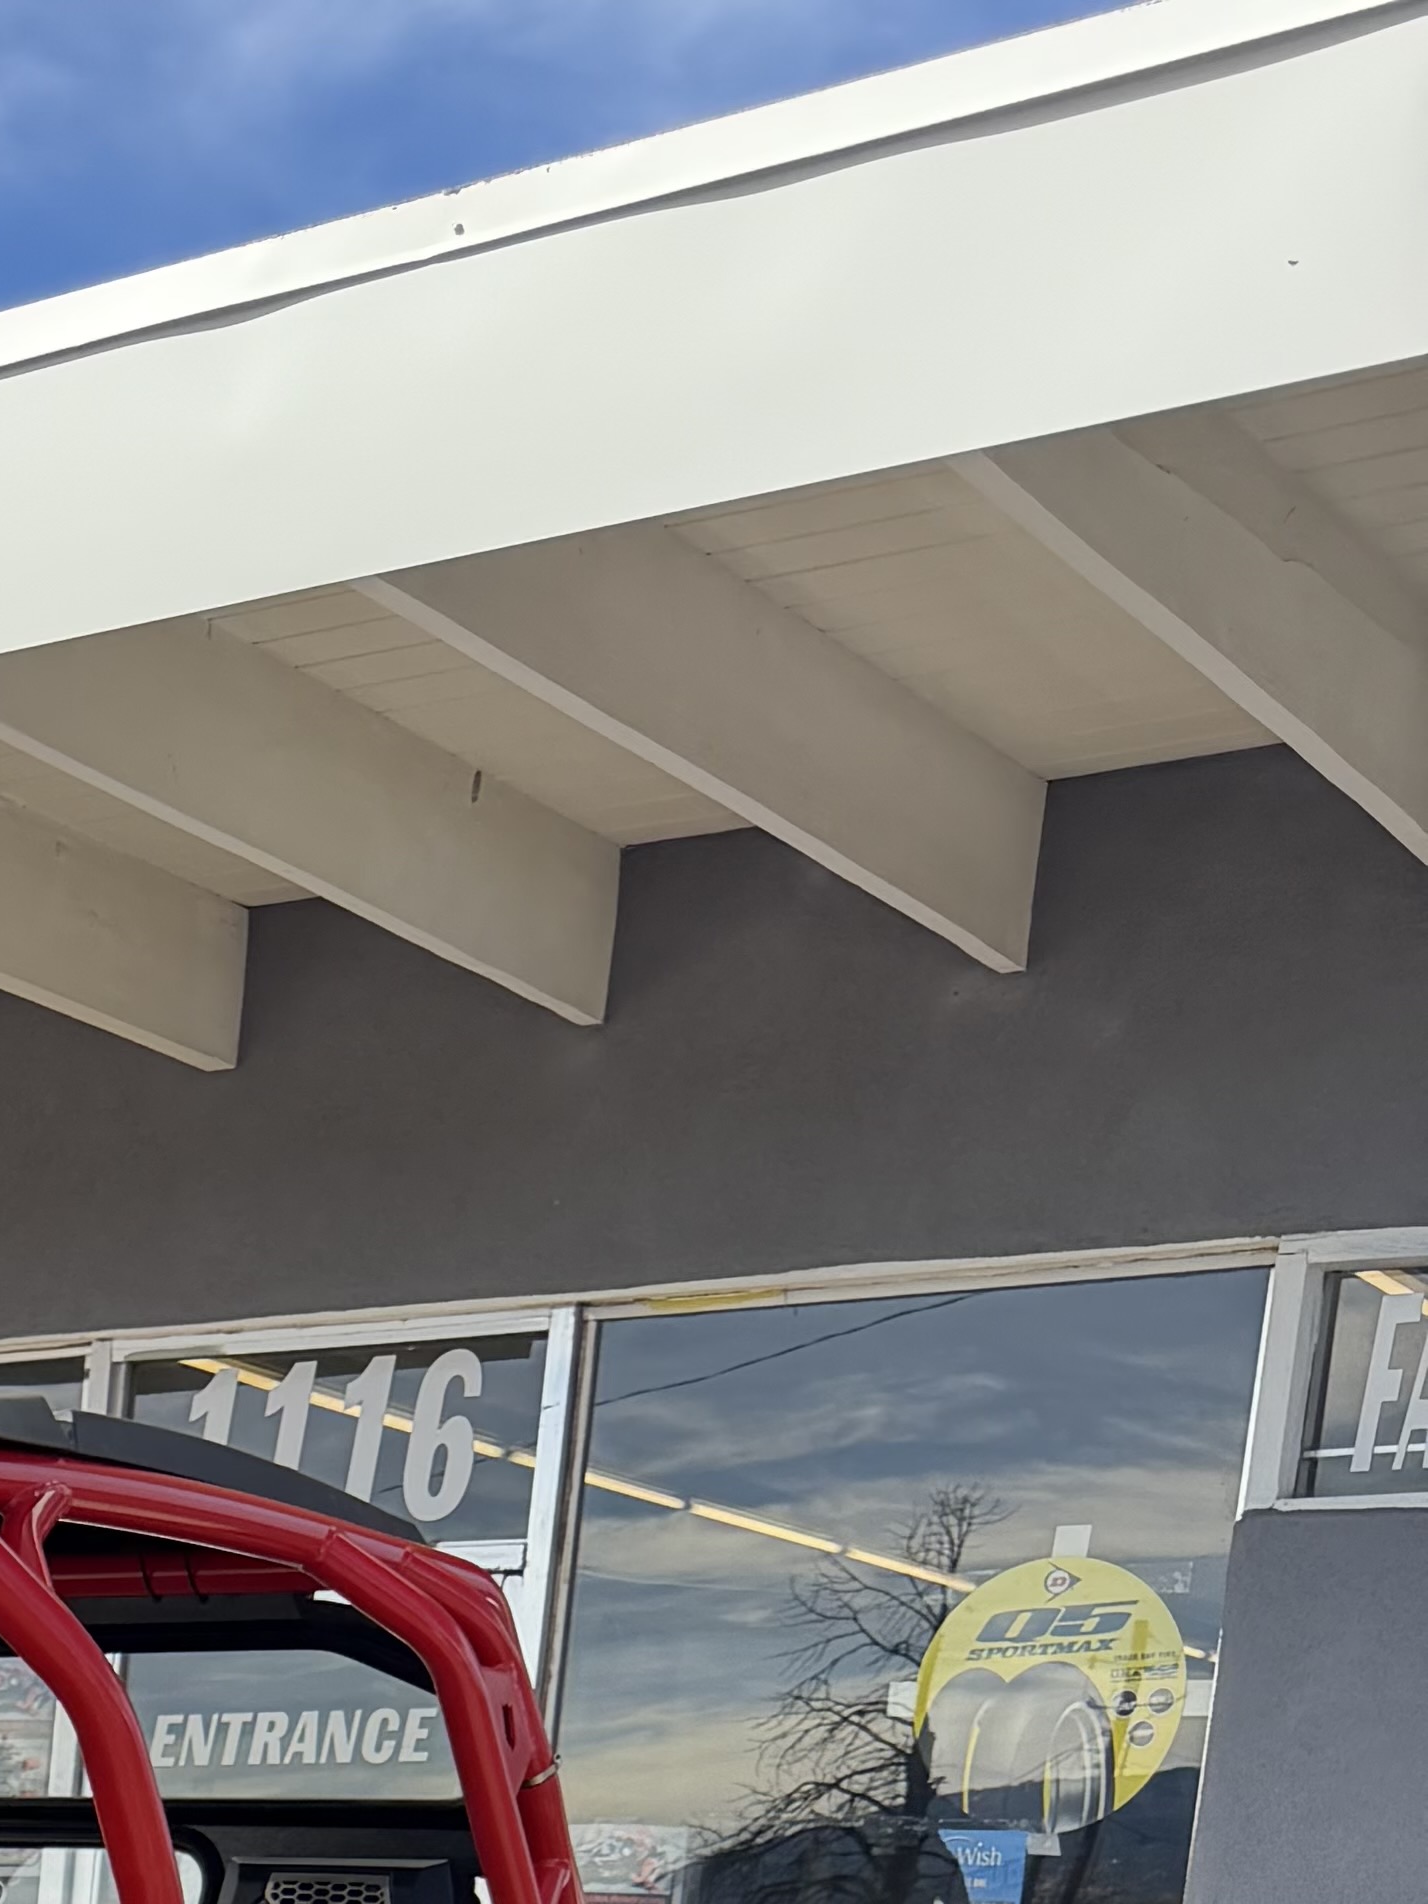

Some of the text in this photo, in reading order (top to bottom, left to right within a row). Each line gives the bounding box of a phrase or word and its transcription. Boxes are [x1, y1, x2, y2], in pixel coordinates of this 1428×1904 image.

[976, 1600, 1139, 1643] Q5
[966, 1638, 1118, 1662] SPORTMAX
[151, 1707, 440, 1768] ENTRANCE
